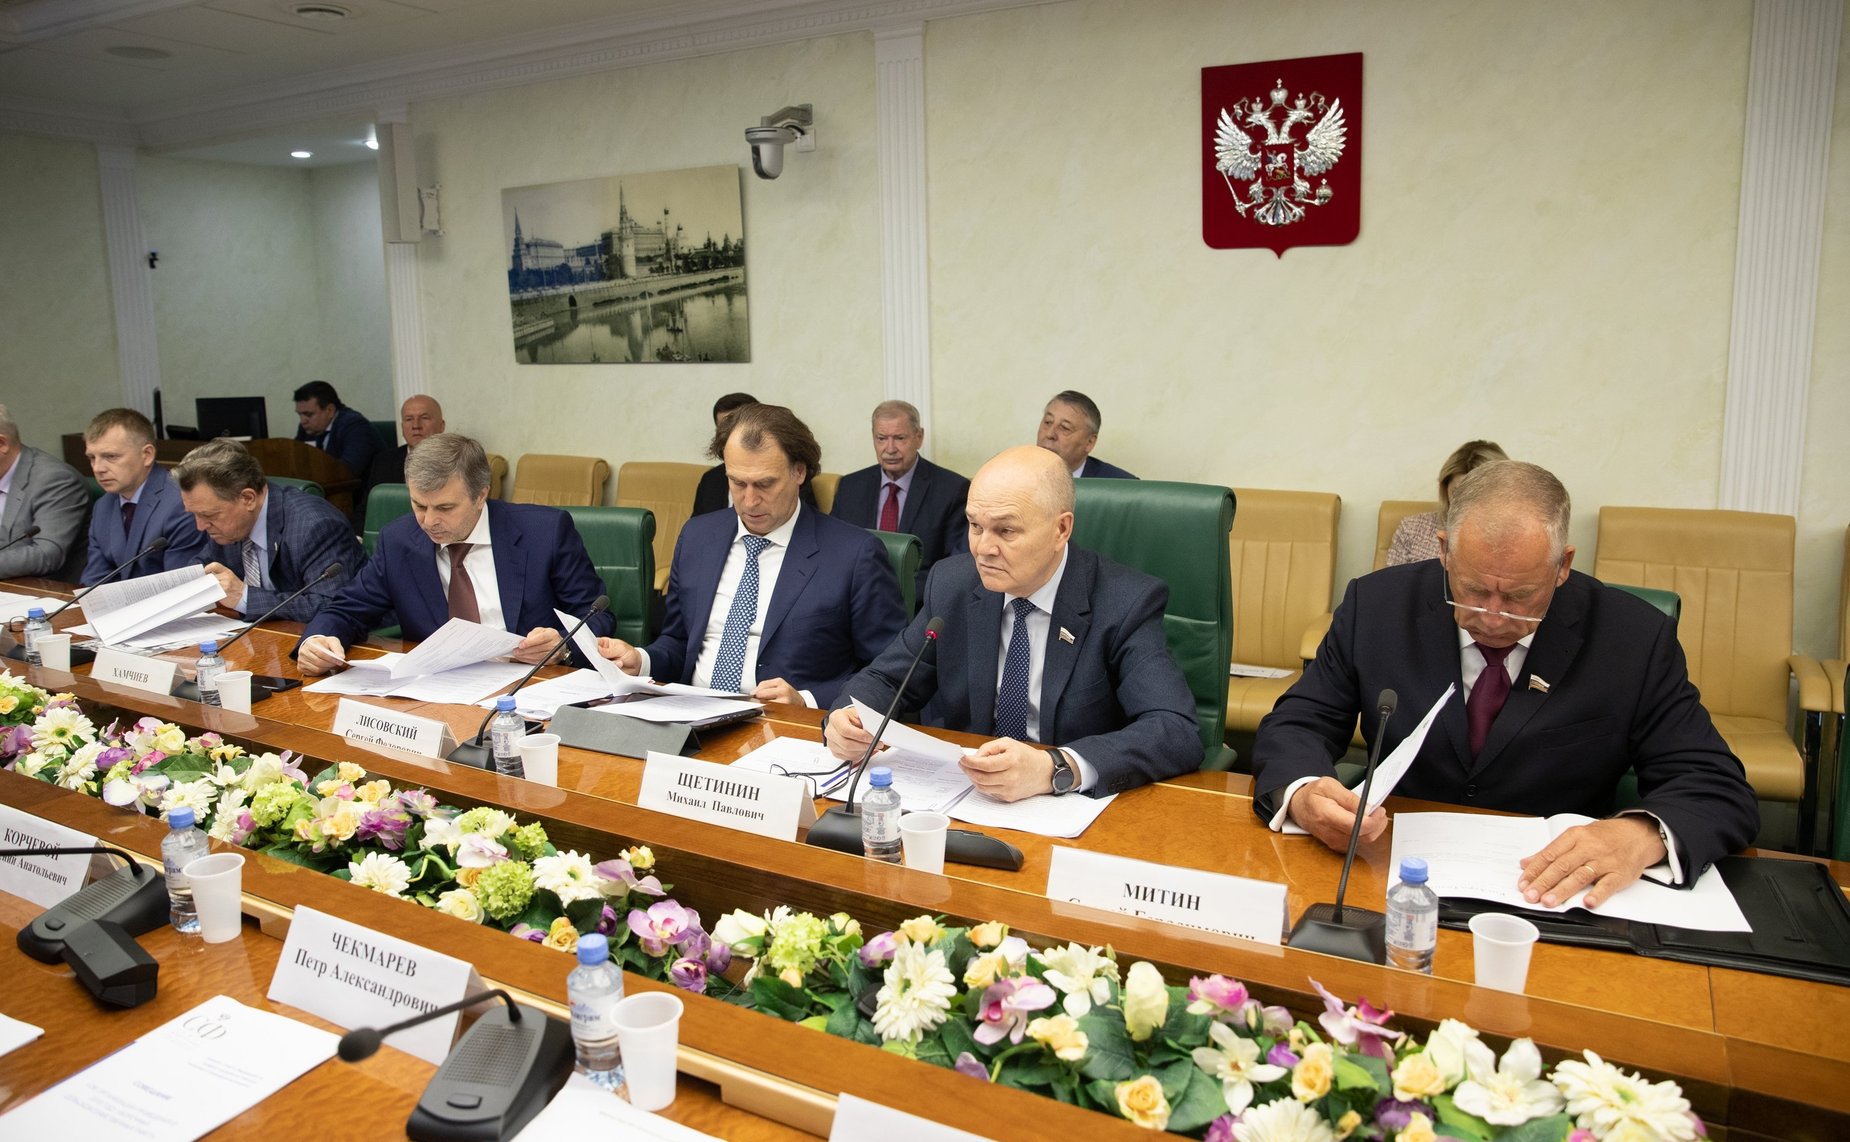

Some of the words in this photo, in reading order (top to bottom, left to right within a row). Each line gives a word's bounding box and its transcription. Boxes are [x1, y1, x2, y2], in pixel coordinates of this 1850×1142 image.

[112, 667, 149, 683] ХАМЧИЕВ
[356, 714, 418, 740] ЛИСОВСКИЙ
[677, 772, 761, 801] ЩЕТИНИН
[666, 790, 707, 808] Михаил
[712, 800, 765, 821] Павлович
[4, 828, 61, 861] КОРЧЕВОЙ
[17, 858, 68, 886] Анатольевич
[1123, 883, 1201, 911] МИТИН
[332, 932, 417, 977] ЧЕКМАРЕВ
[294, 948, 328, 978] Петр
[330, 963, 440, 1015] Александрович
